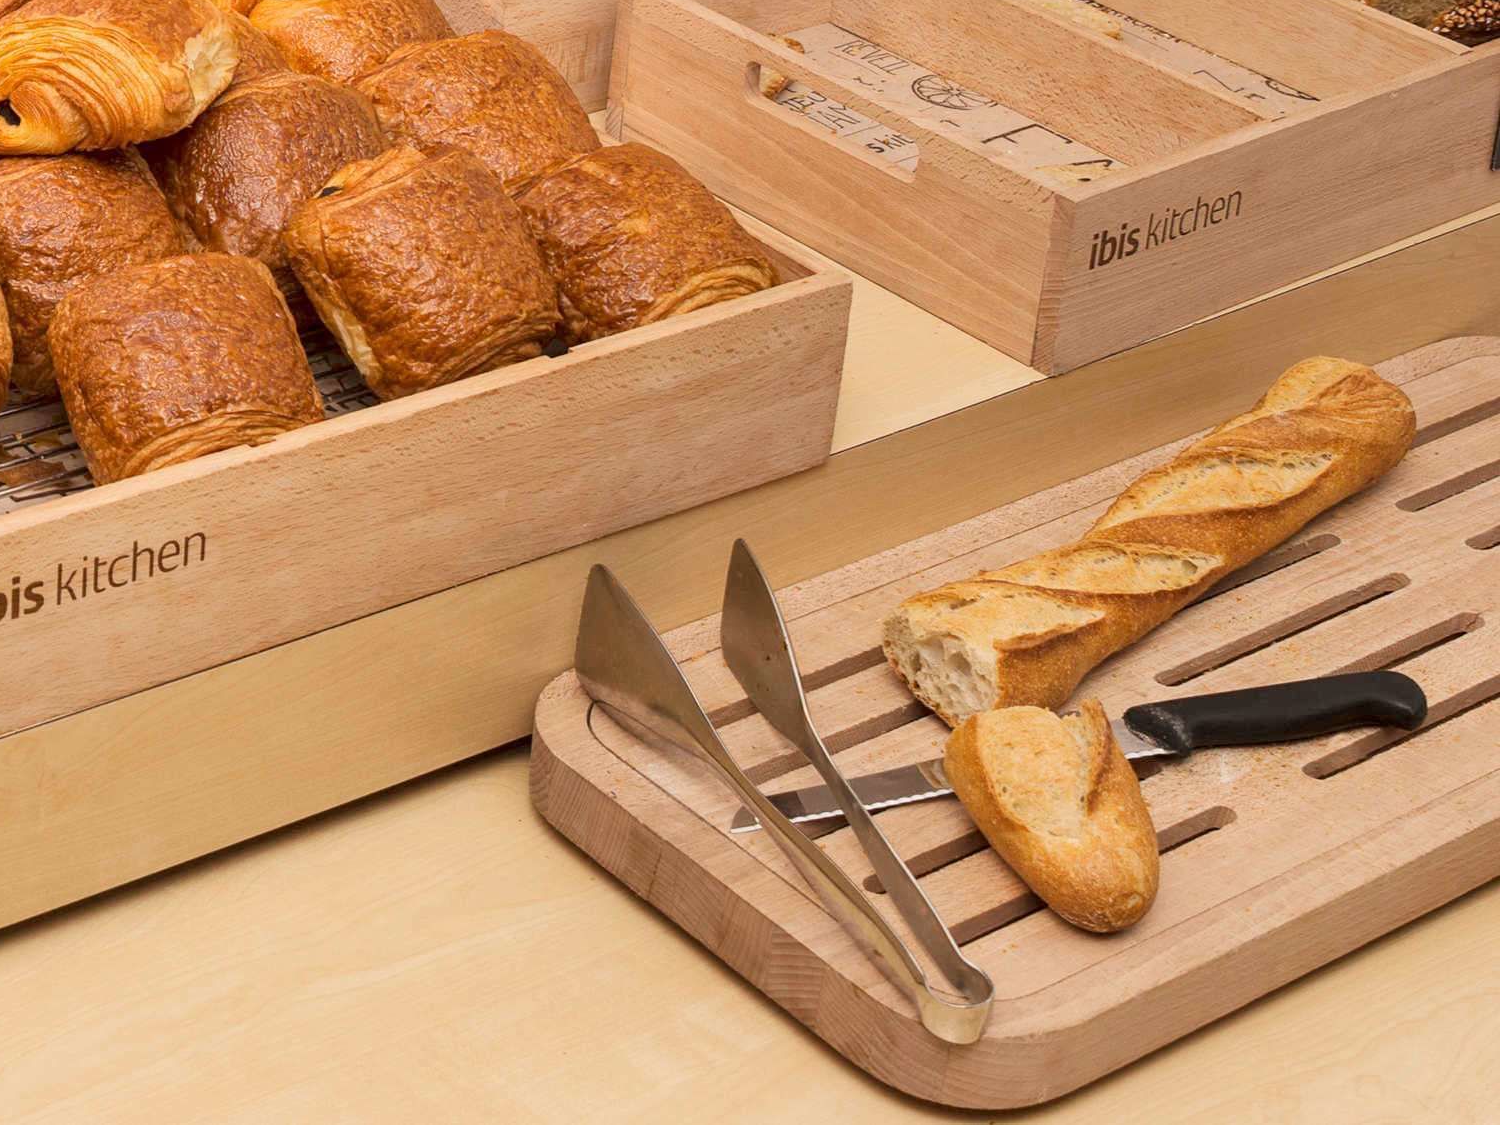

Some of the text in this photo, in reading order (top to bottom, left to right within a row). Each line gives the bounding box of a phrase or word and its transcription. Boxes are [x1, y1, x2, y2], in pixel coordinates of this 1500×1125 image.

[1088, 190, 1242, 271] ibis kitchen
[56, 532, 207, 606] kitchen
